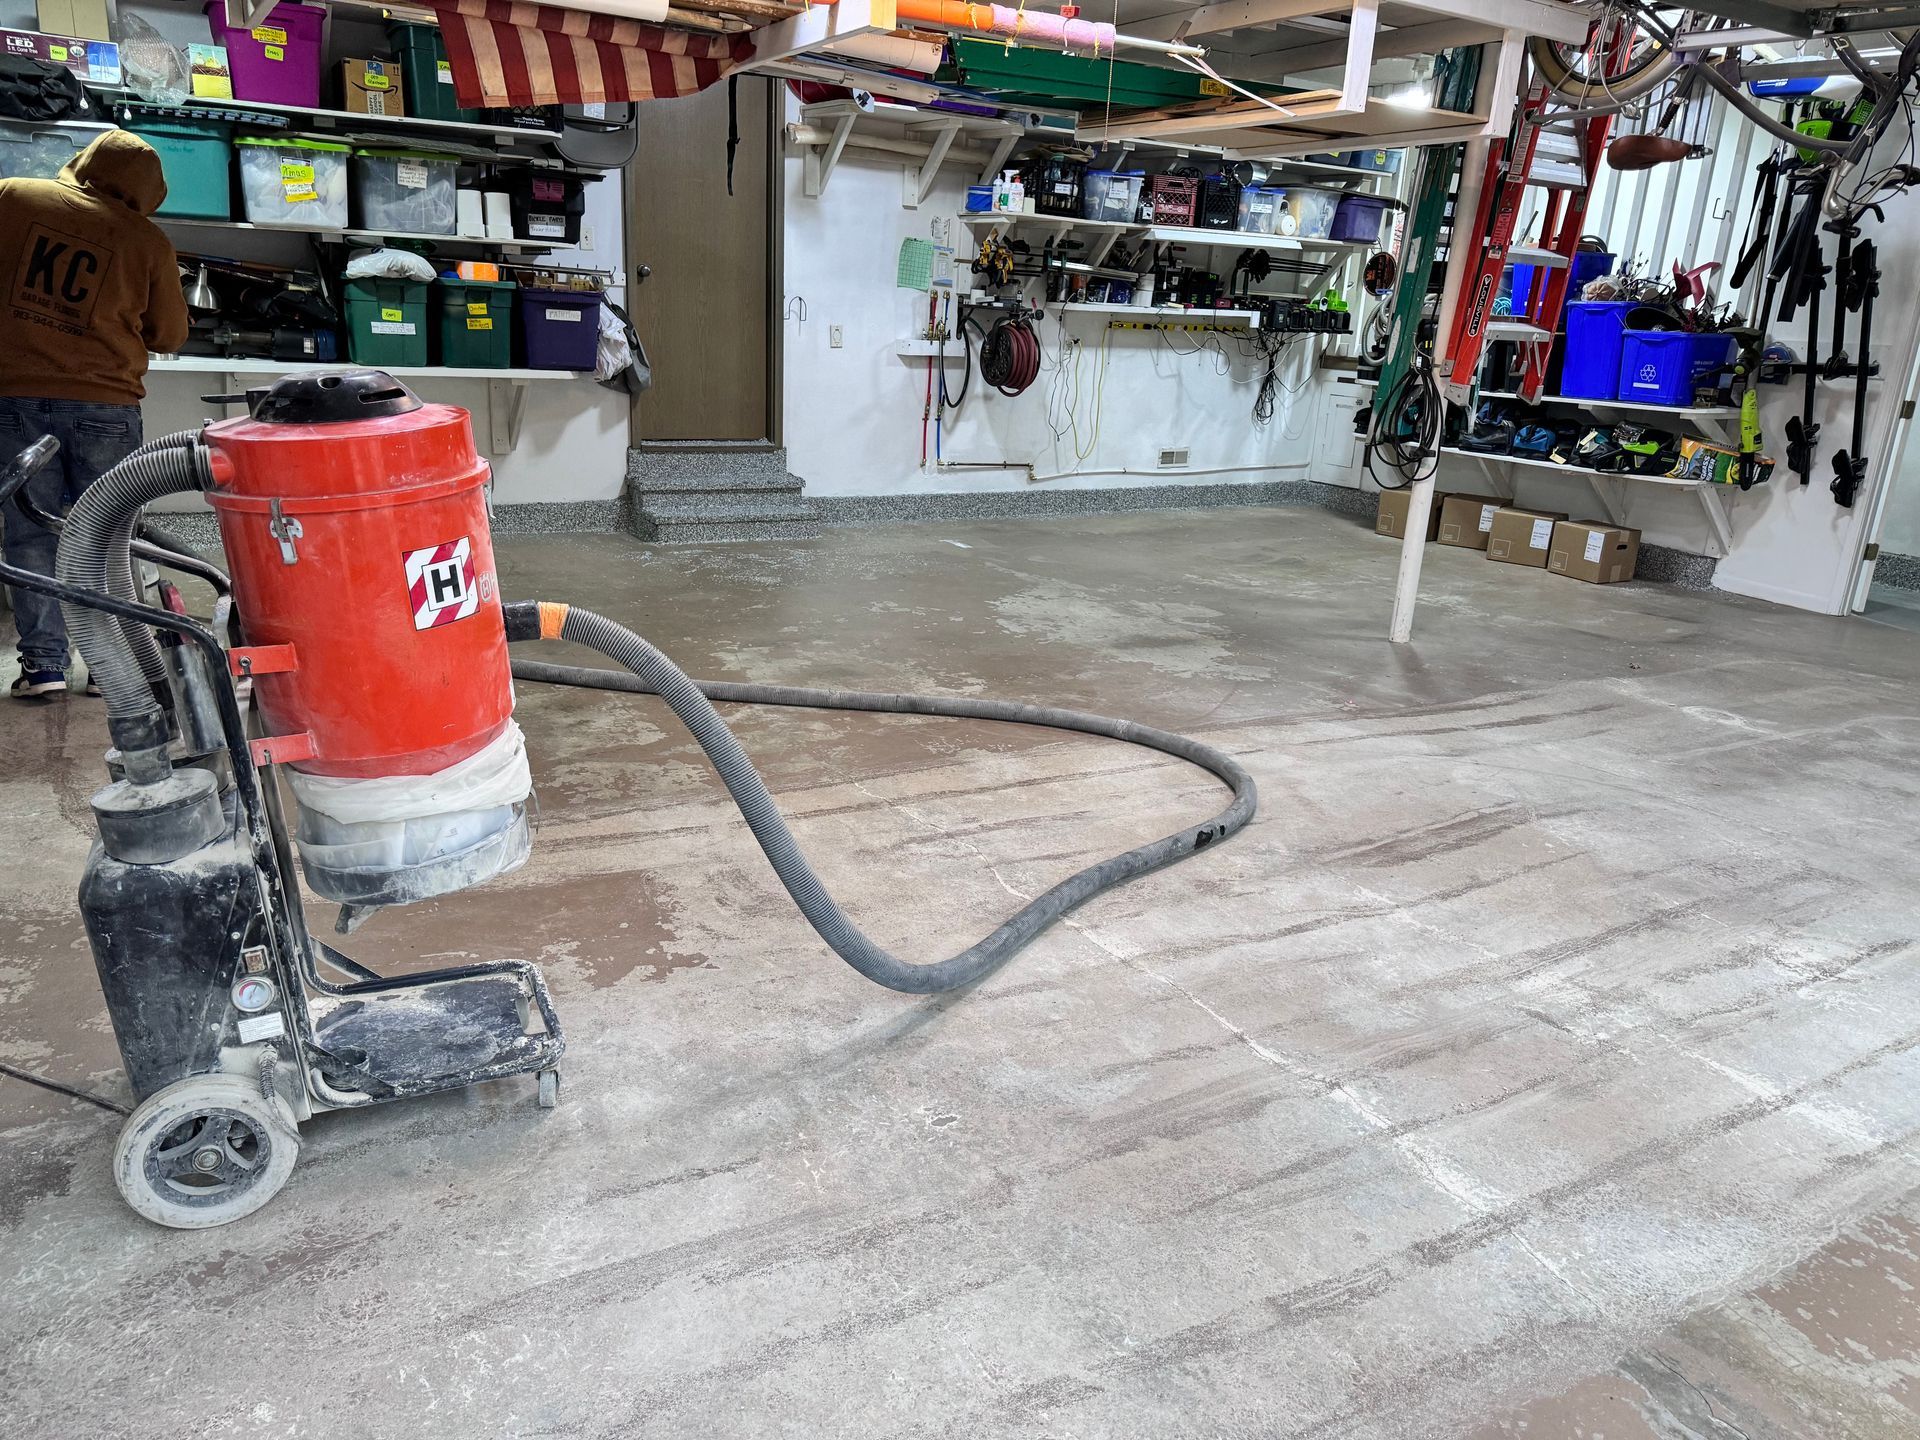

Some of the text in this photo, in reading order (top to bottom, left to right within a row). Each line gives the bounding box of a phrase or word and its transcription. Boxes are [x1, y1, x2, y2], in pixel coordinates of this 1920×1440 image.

[6, 37, 34, 48] LED
[281, 165, 307, 177] Xmas
[24, 235, 98, 303] KC
[1470, 285, 1488, 335] LOUISVILLE
[430, 564, 462, 604] H
